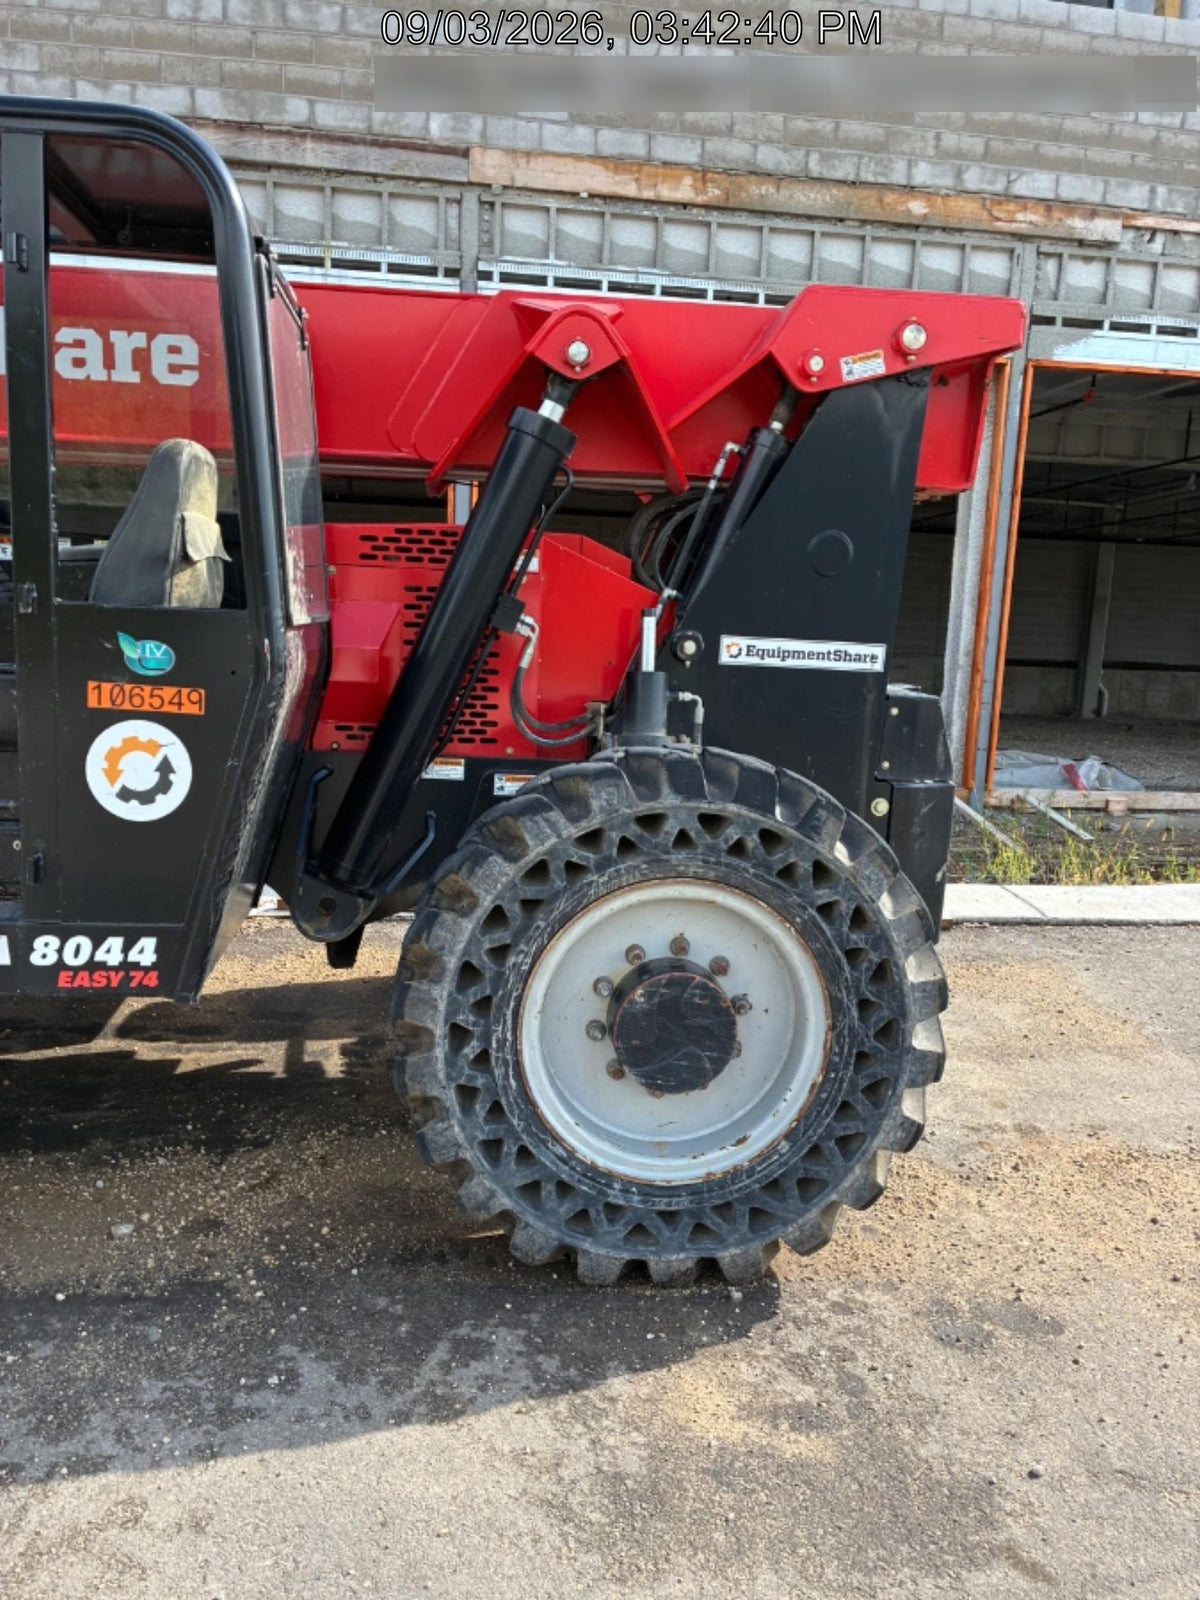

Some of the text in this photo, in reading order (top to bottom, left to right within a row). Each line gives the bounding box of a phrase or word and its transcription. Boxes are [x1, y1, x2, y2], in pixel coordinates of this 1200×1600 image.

[745, 645, 879, 664] EquipmentShare
[92, 684, 203, 712] 106549
[29, 935, 157, 966] 8044
[58, 970, 159, 988] EASY 74
